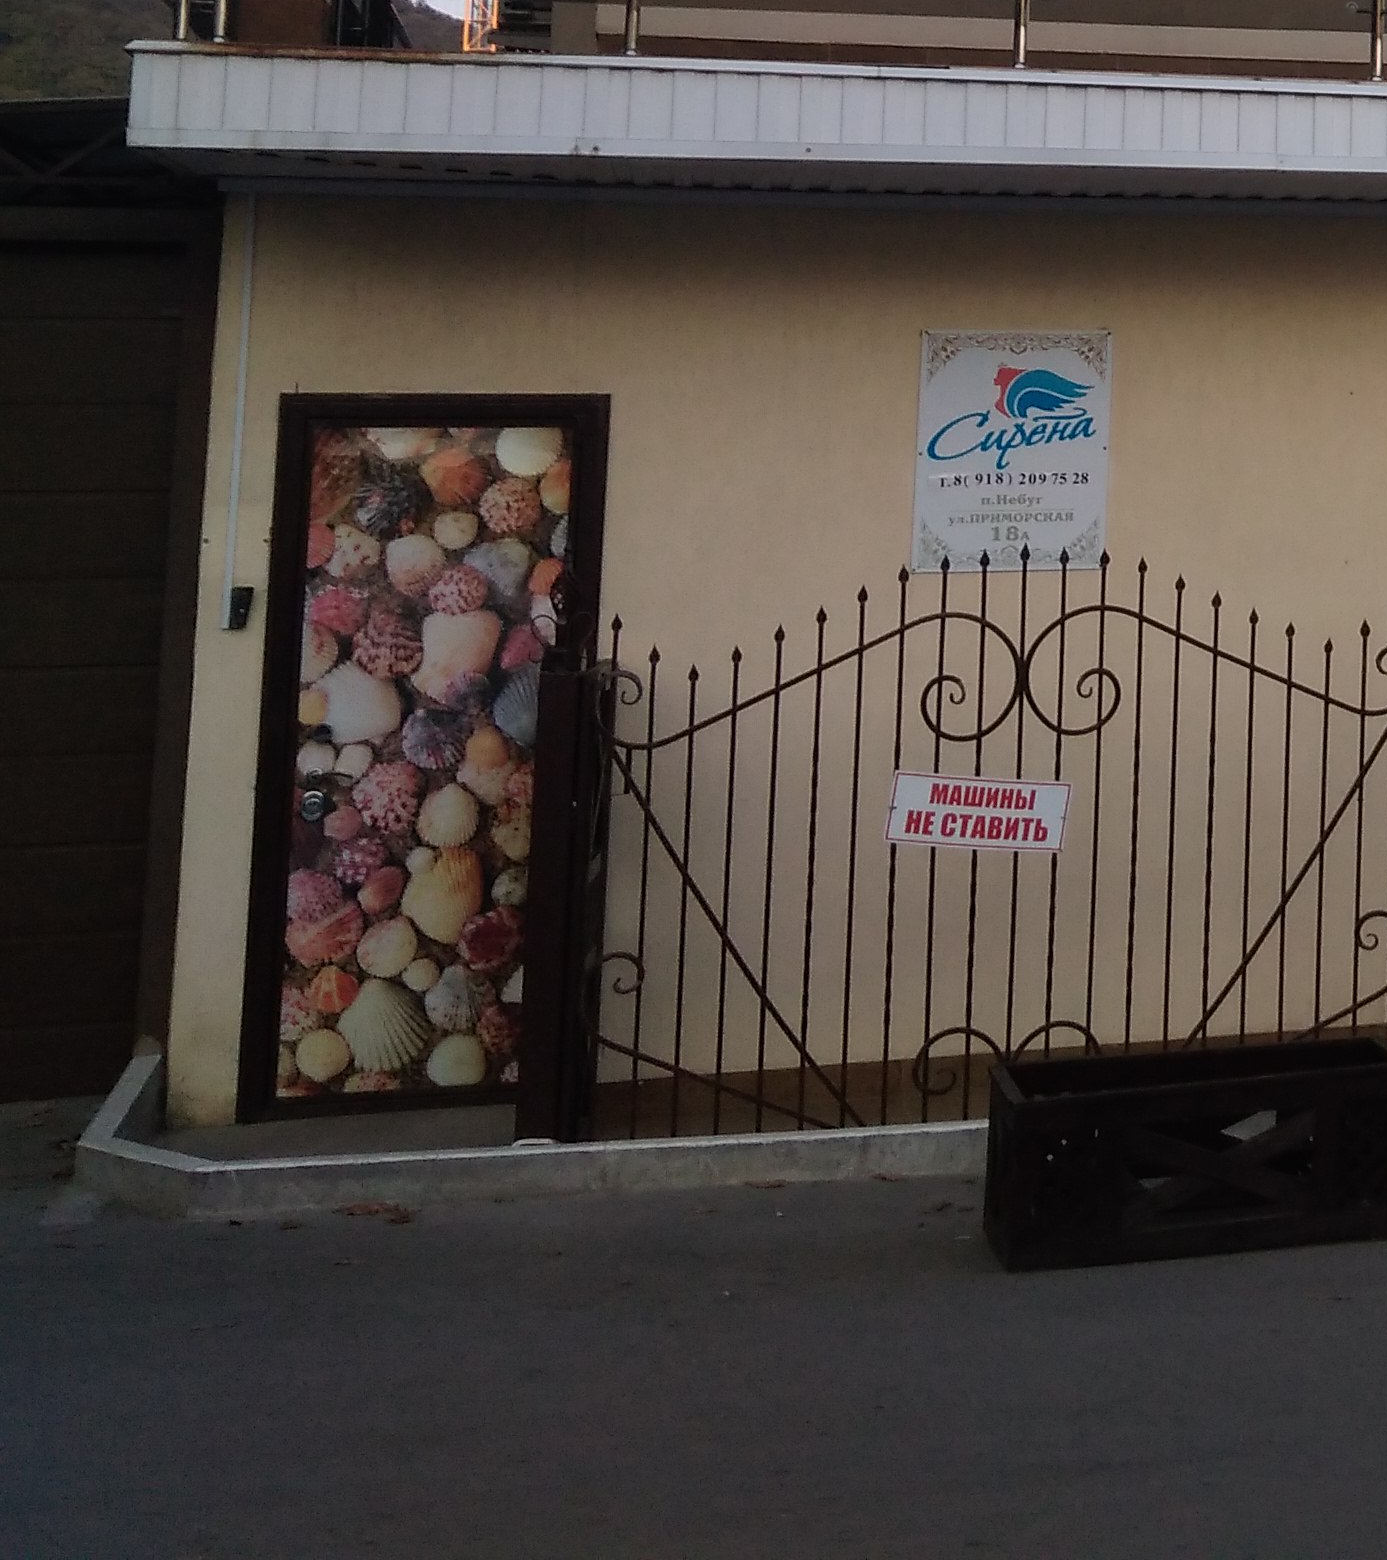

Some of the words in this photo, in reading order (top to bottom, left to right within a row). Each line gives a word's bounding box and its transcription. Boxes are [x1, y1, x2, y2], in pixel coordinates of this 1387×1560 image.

[927, 408, 1096, 470] Сирена
[1019, 472, 1047, 485] 209
[1051, 472, 1068, 485] 75
[1073, 472, 1090, 485] 28
[929, 782, 1037, 811] МАШИНЫ
[904, 809, 936, 836] НЕ
[940, 813, 1048, 842] СТАВИТЬ
